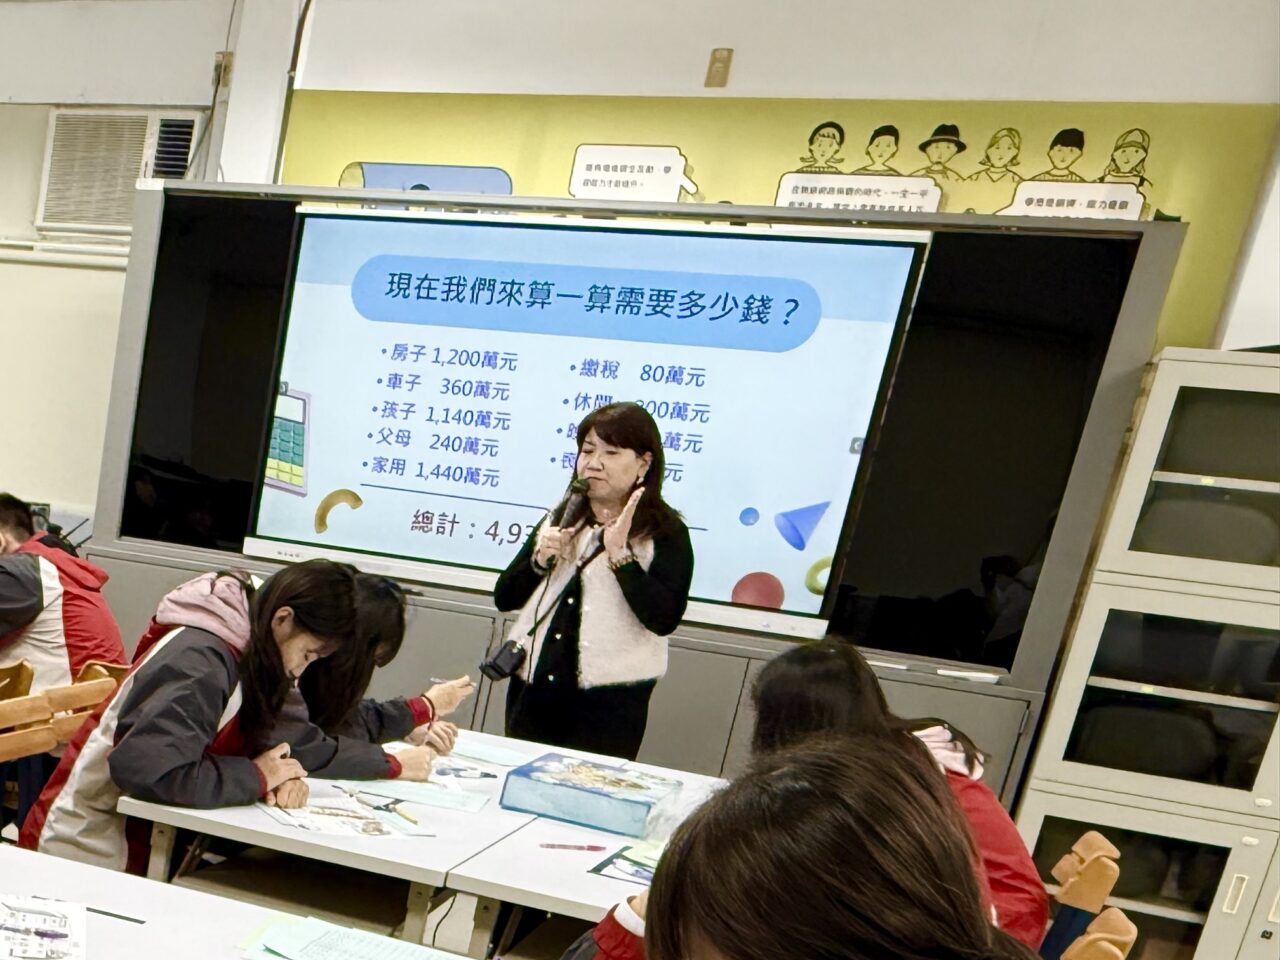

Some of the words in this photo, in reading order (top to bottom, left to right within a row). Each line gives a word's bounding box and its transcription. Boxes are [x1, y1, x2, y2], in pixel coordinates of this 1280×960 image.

[385, 271, 801, 327] 現在我們來算一算需要多少錢？
[390, 343, 426, 363] 房子
[431, 347, 518, 371] 1,200萬元
[386, 373, 422, 391] 車子
[439, 378, 510, 400] 360萬元
[579, 358, 620, 379] 繳稅
[639, 364, 706, 388] 80萬元
[381, 401, 416, 419] 孩子
[425, 406, 511, 430] 1,140萬元
[376, 427, 412, 447] 父母
[429, 434, 499, 457] 240萬元
[662, 431, 703, 453] 萬元
[371, 456, 406, 476] 家用
[415, 462, 500, 487] 1,440萬元
